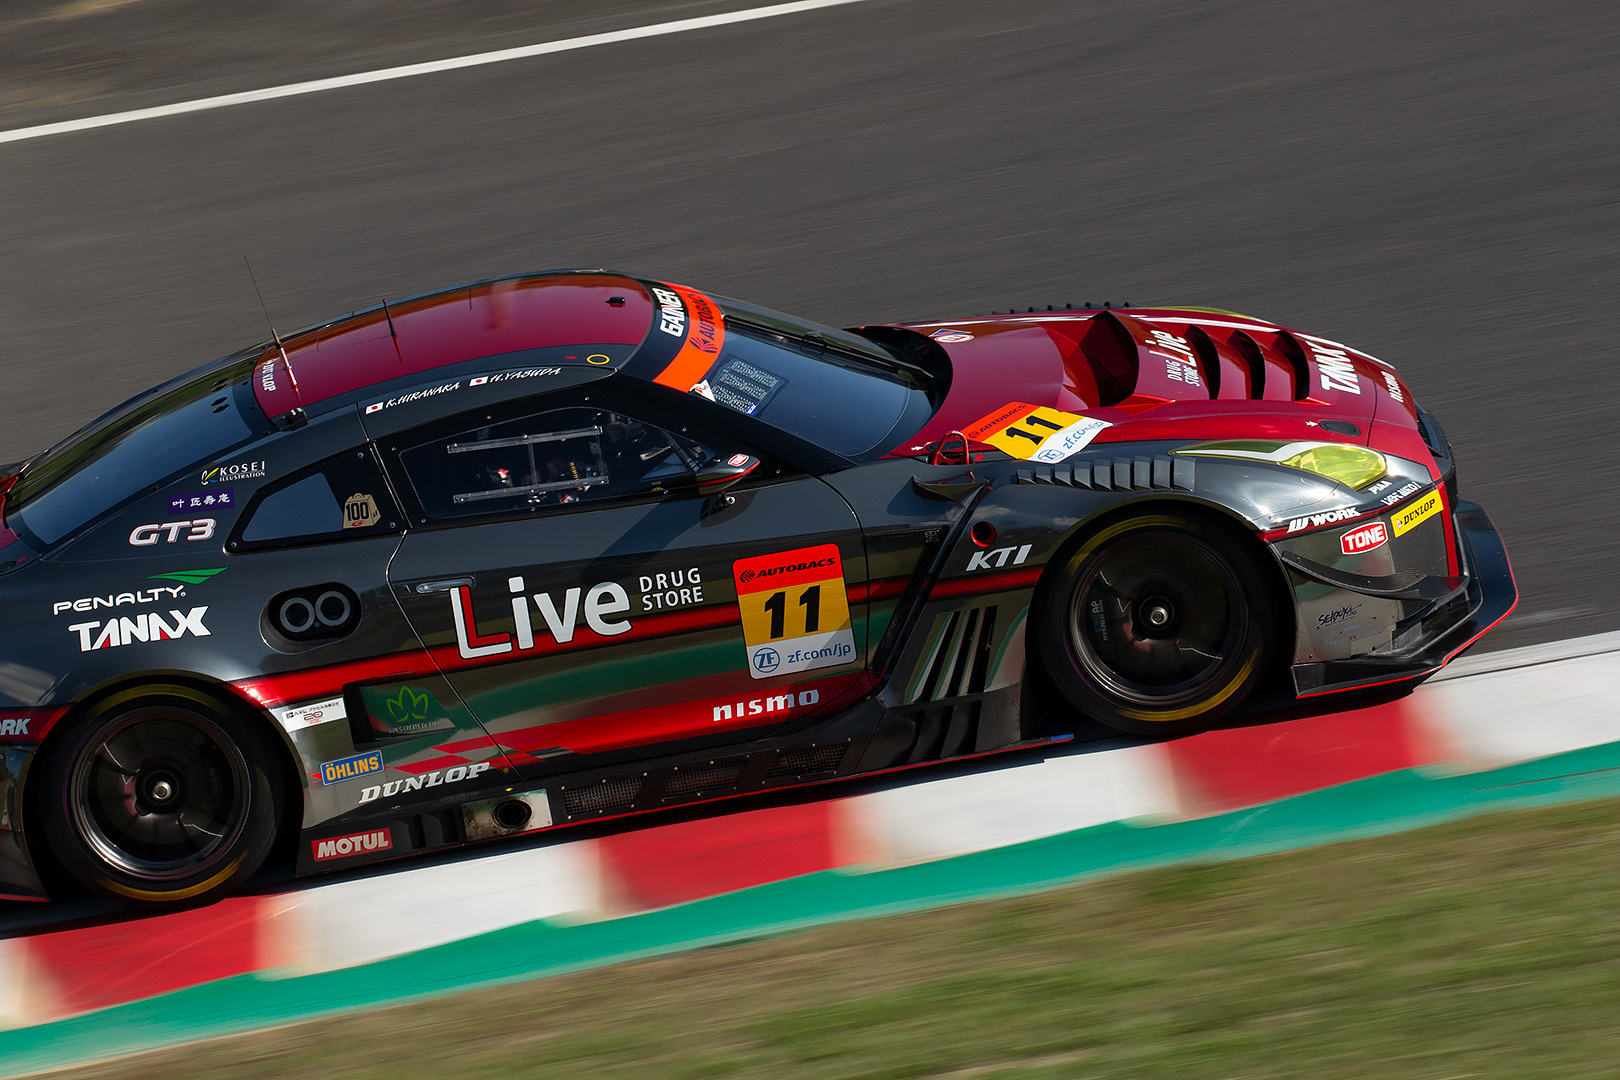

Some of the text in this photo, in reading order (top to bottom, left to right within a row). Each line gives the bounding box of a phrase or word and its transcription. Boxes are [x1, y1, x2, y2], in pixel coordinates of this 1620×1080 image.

[652, 288, 685, 337] GAINER
[980, 404, 1026, 432] AUTOBACS
[1006, 415, 1064, 445] 11
[219, 471, 265, 482] ILLUSTRATION
[220, 460, 265, 476] KOSEI
[345, 502, 369, 521] 100
[1310, 506, 1361, 527] WORK
[1404, 498, 1436, 525] DUNLOP
[129, 517, 216, 546] GT3
[1344, 525, 1385, 551] TONE
[755, 558, 836, 578] AUTOBACS
[966, 544, 1033, 572] KTI
[639, 567, 702, 594] DRUG
[53, 585, 184, 615] PENALTY
[641, 584, 704, 612] STORE
[764, 585, 820, 639] 11
[68, 605, 212, 652] TANAX
[449, 576, 633, 659] Live
[788, 643, 851, 664] zf.com/jp
[713, 688, 820, 722] nismo
[0, 718, 31, 735] RK
[325, 754, 380, 782] ÖHLINS
[358, 762, 490, 805] DUNLOP
[317, 831, 389, 859] MOTUL
